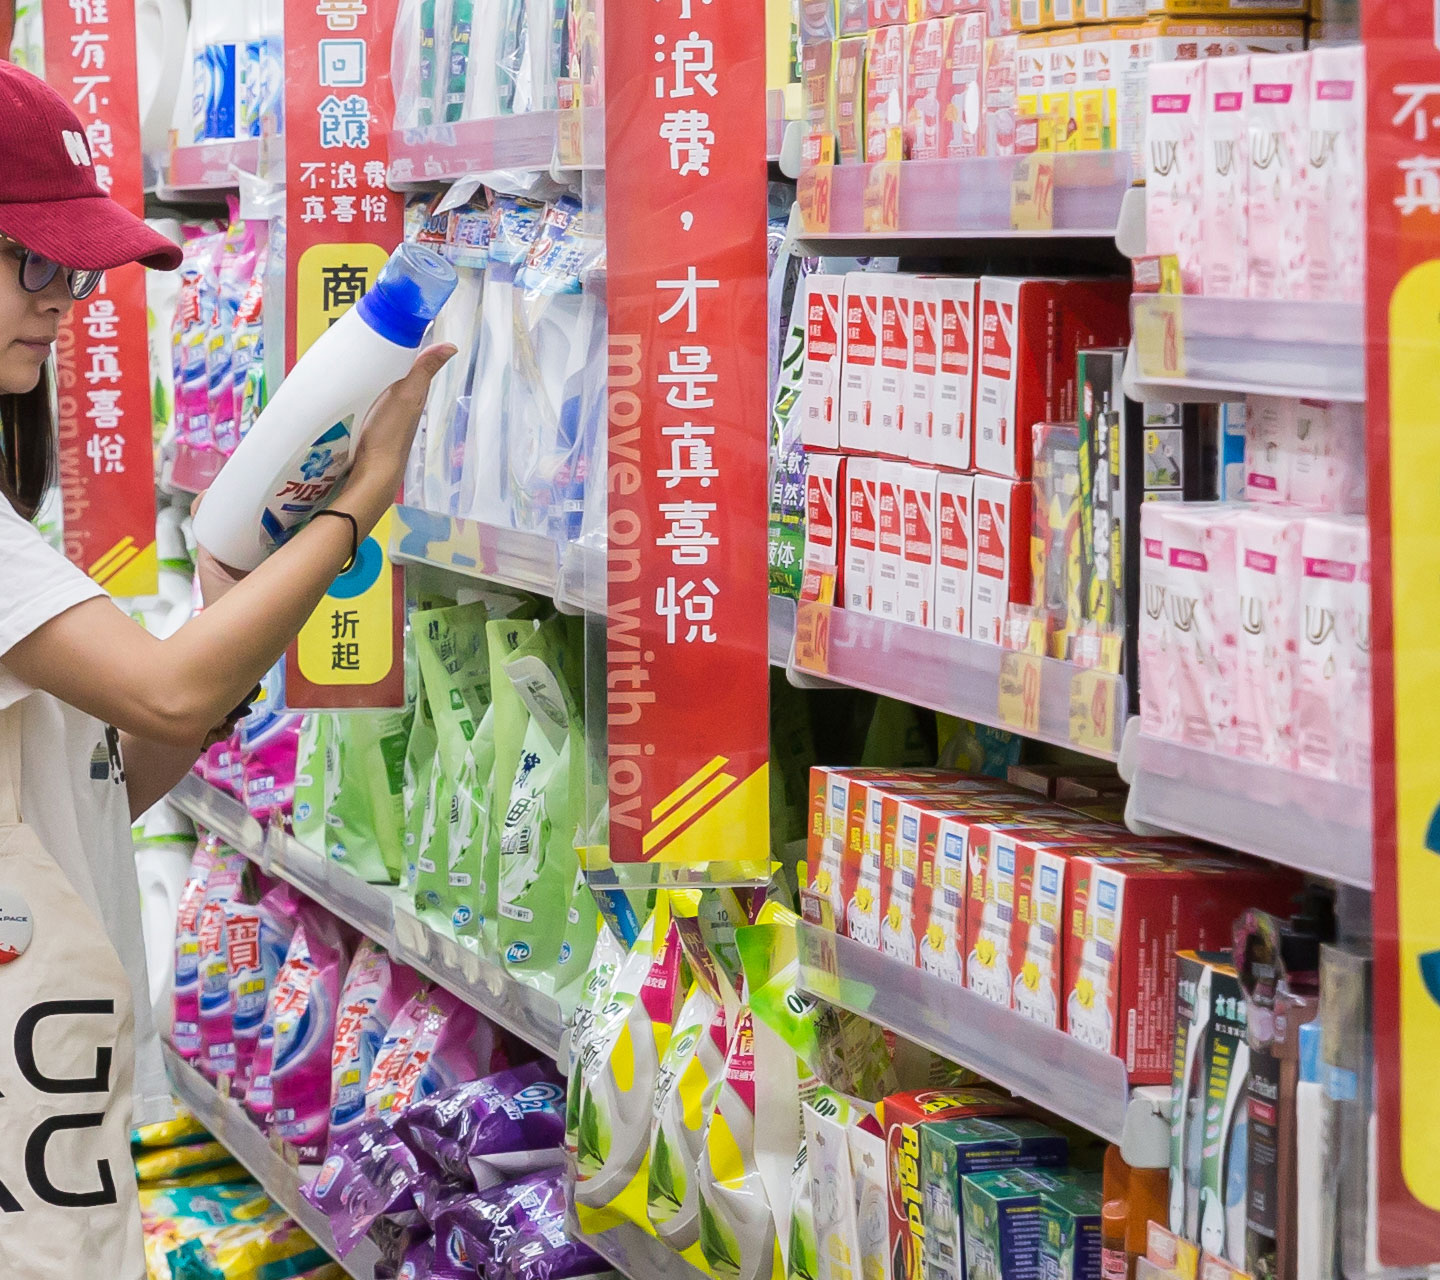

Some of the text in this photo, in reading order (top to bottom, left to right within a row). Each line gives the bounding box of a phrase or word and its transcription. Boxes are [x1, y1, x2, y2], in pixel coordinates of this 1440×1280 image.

[300, 160, 387, 189] 不浪費
[300, 194, 388, 224] 真喜悅
[607, 334, 642, 486] move
[607, 523, 641, 582] on
[330, 610, 361, 671] 折起
[607, 597, 656, 726] with
